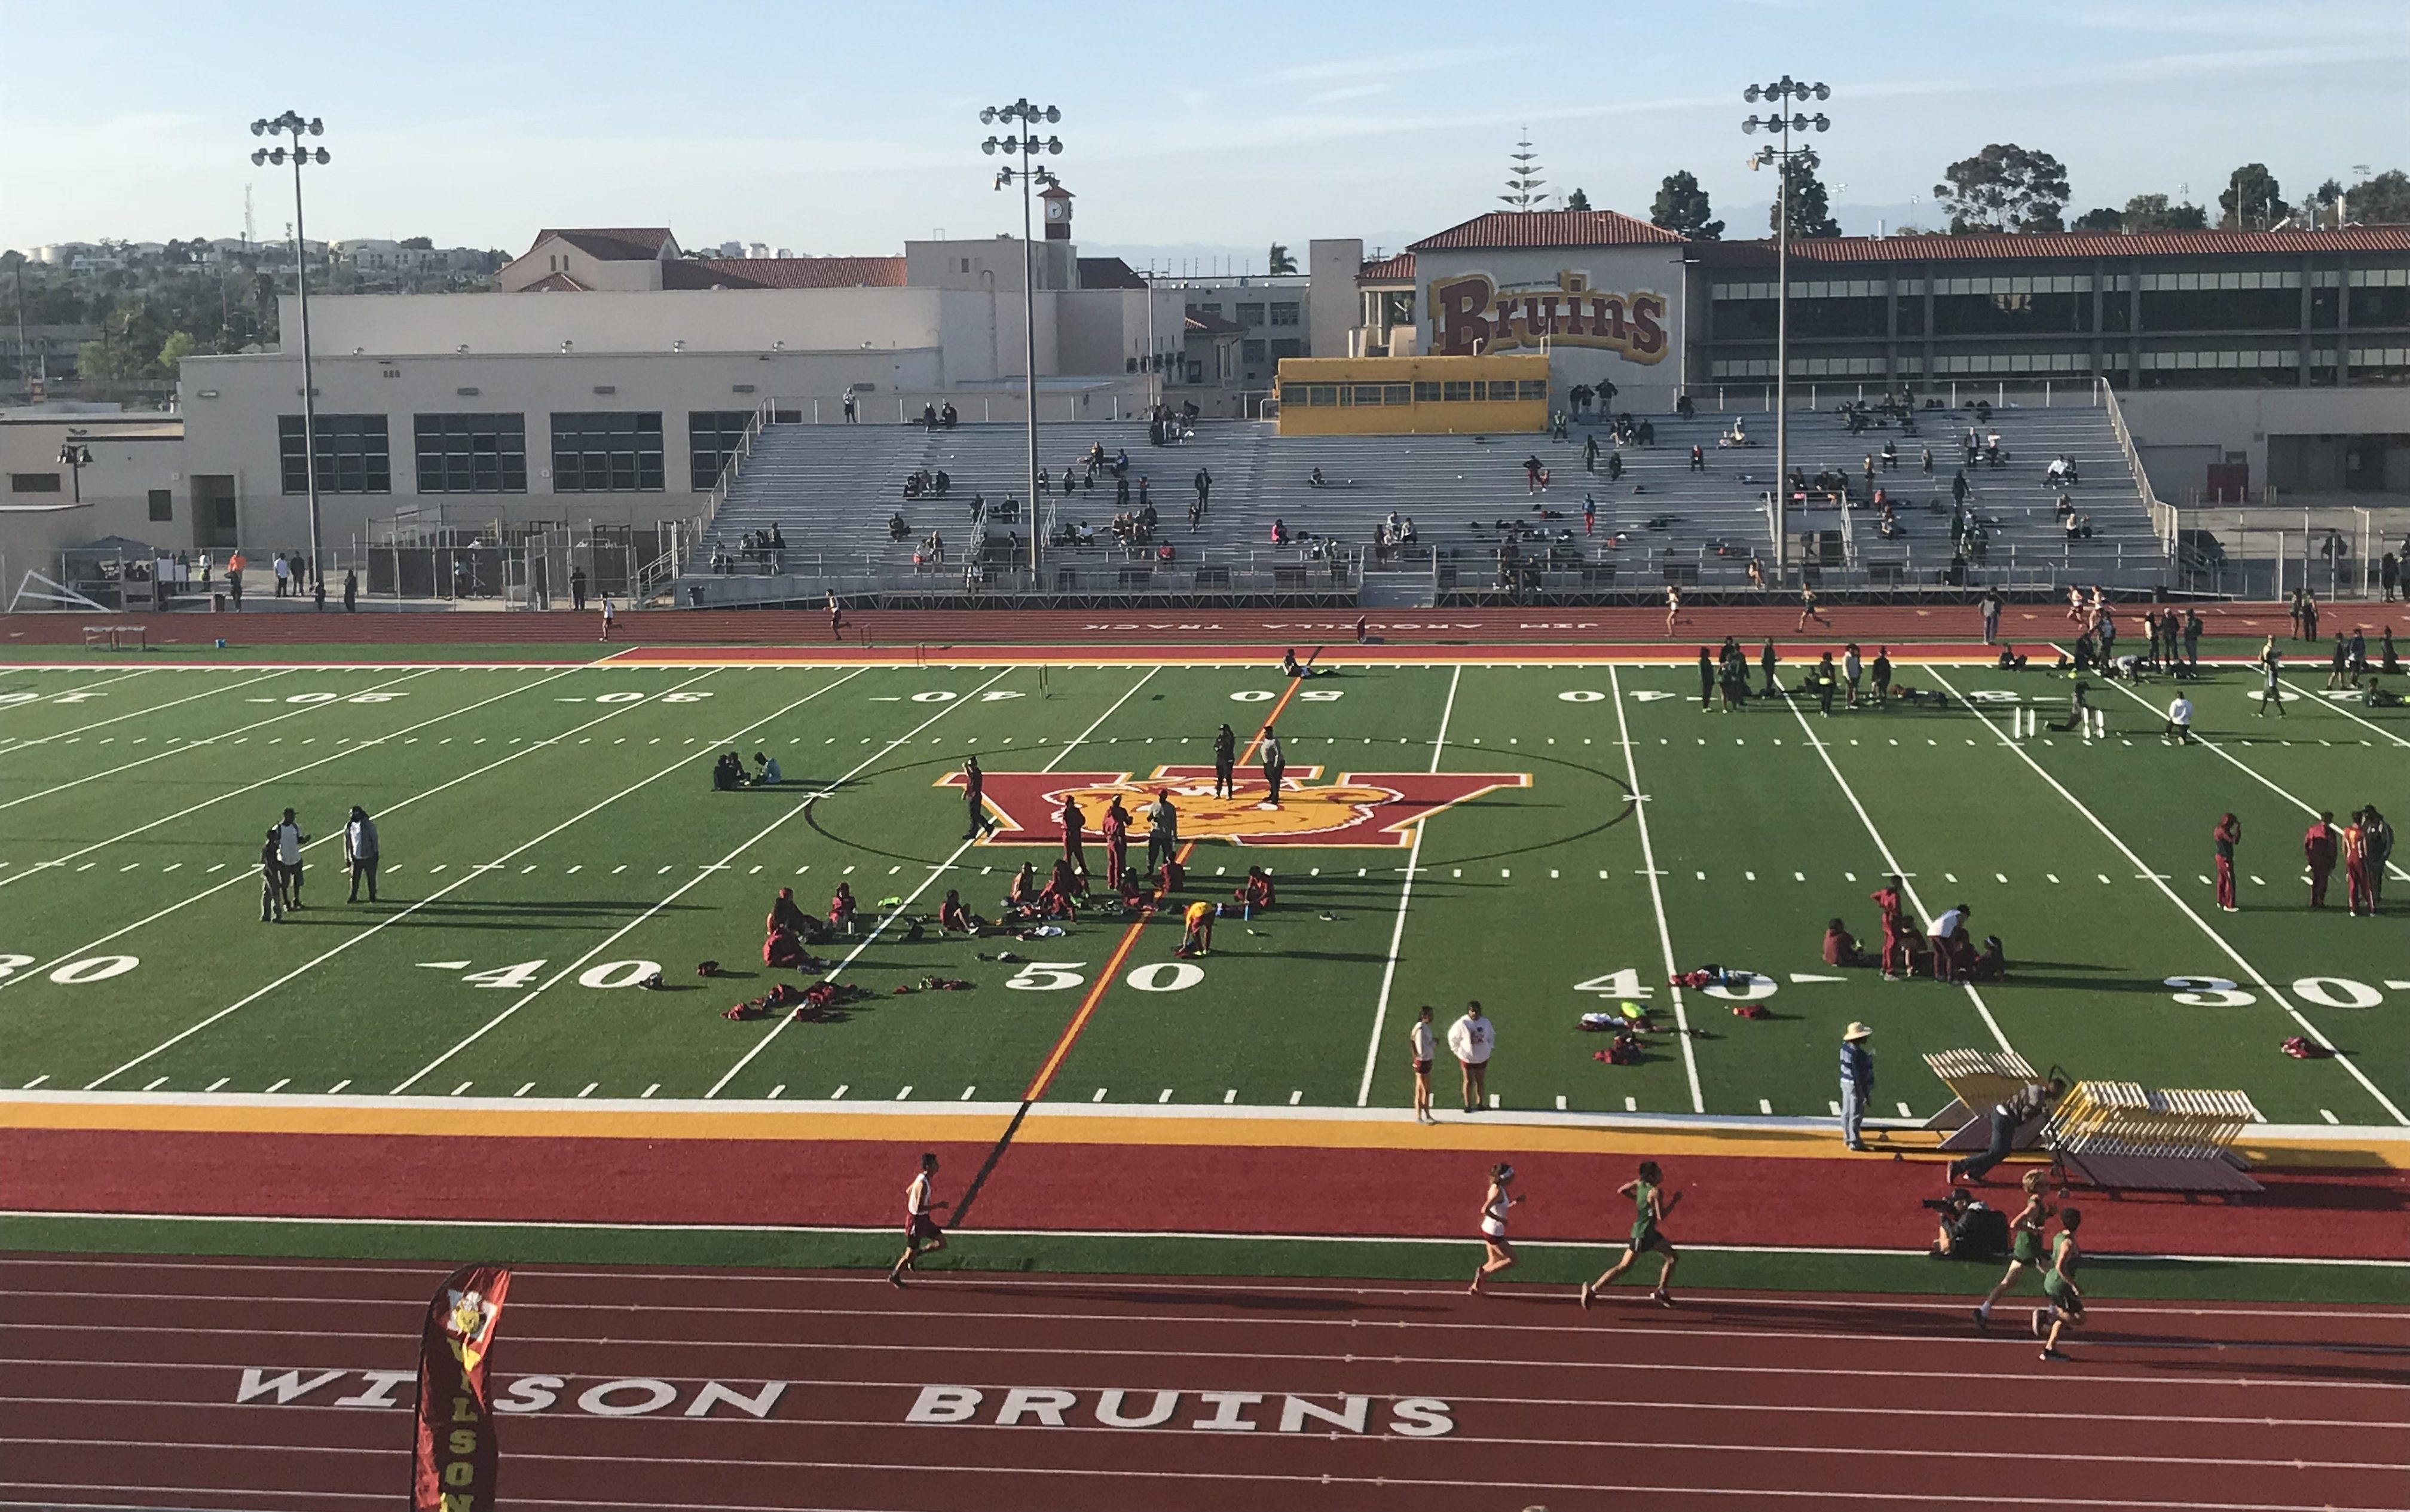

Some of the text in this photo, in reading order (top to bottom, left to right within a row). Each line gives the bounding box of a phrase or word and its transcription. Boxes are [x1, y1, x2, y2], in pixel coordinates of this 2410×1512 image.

[1438, 277, 1666, 356] Bruins
[1005, 962, 1205, 991] 50
[2163, 975, 2383, 1008] 30
[236, 1366, 1458, 1437] WISON BRUINS
